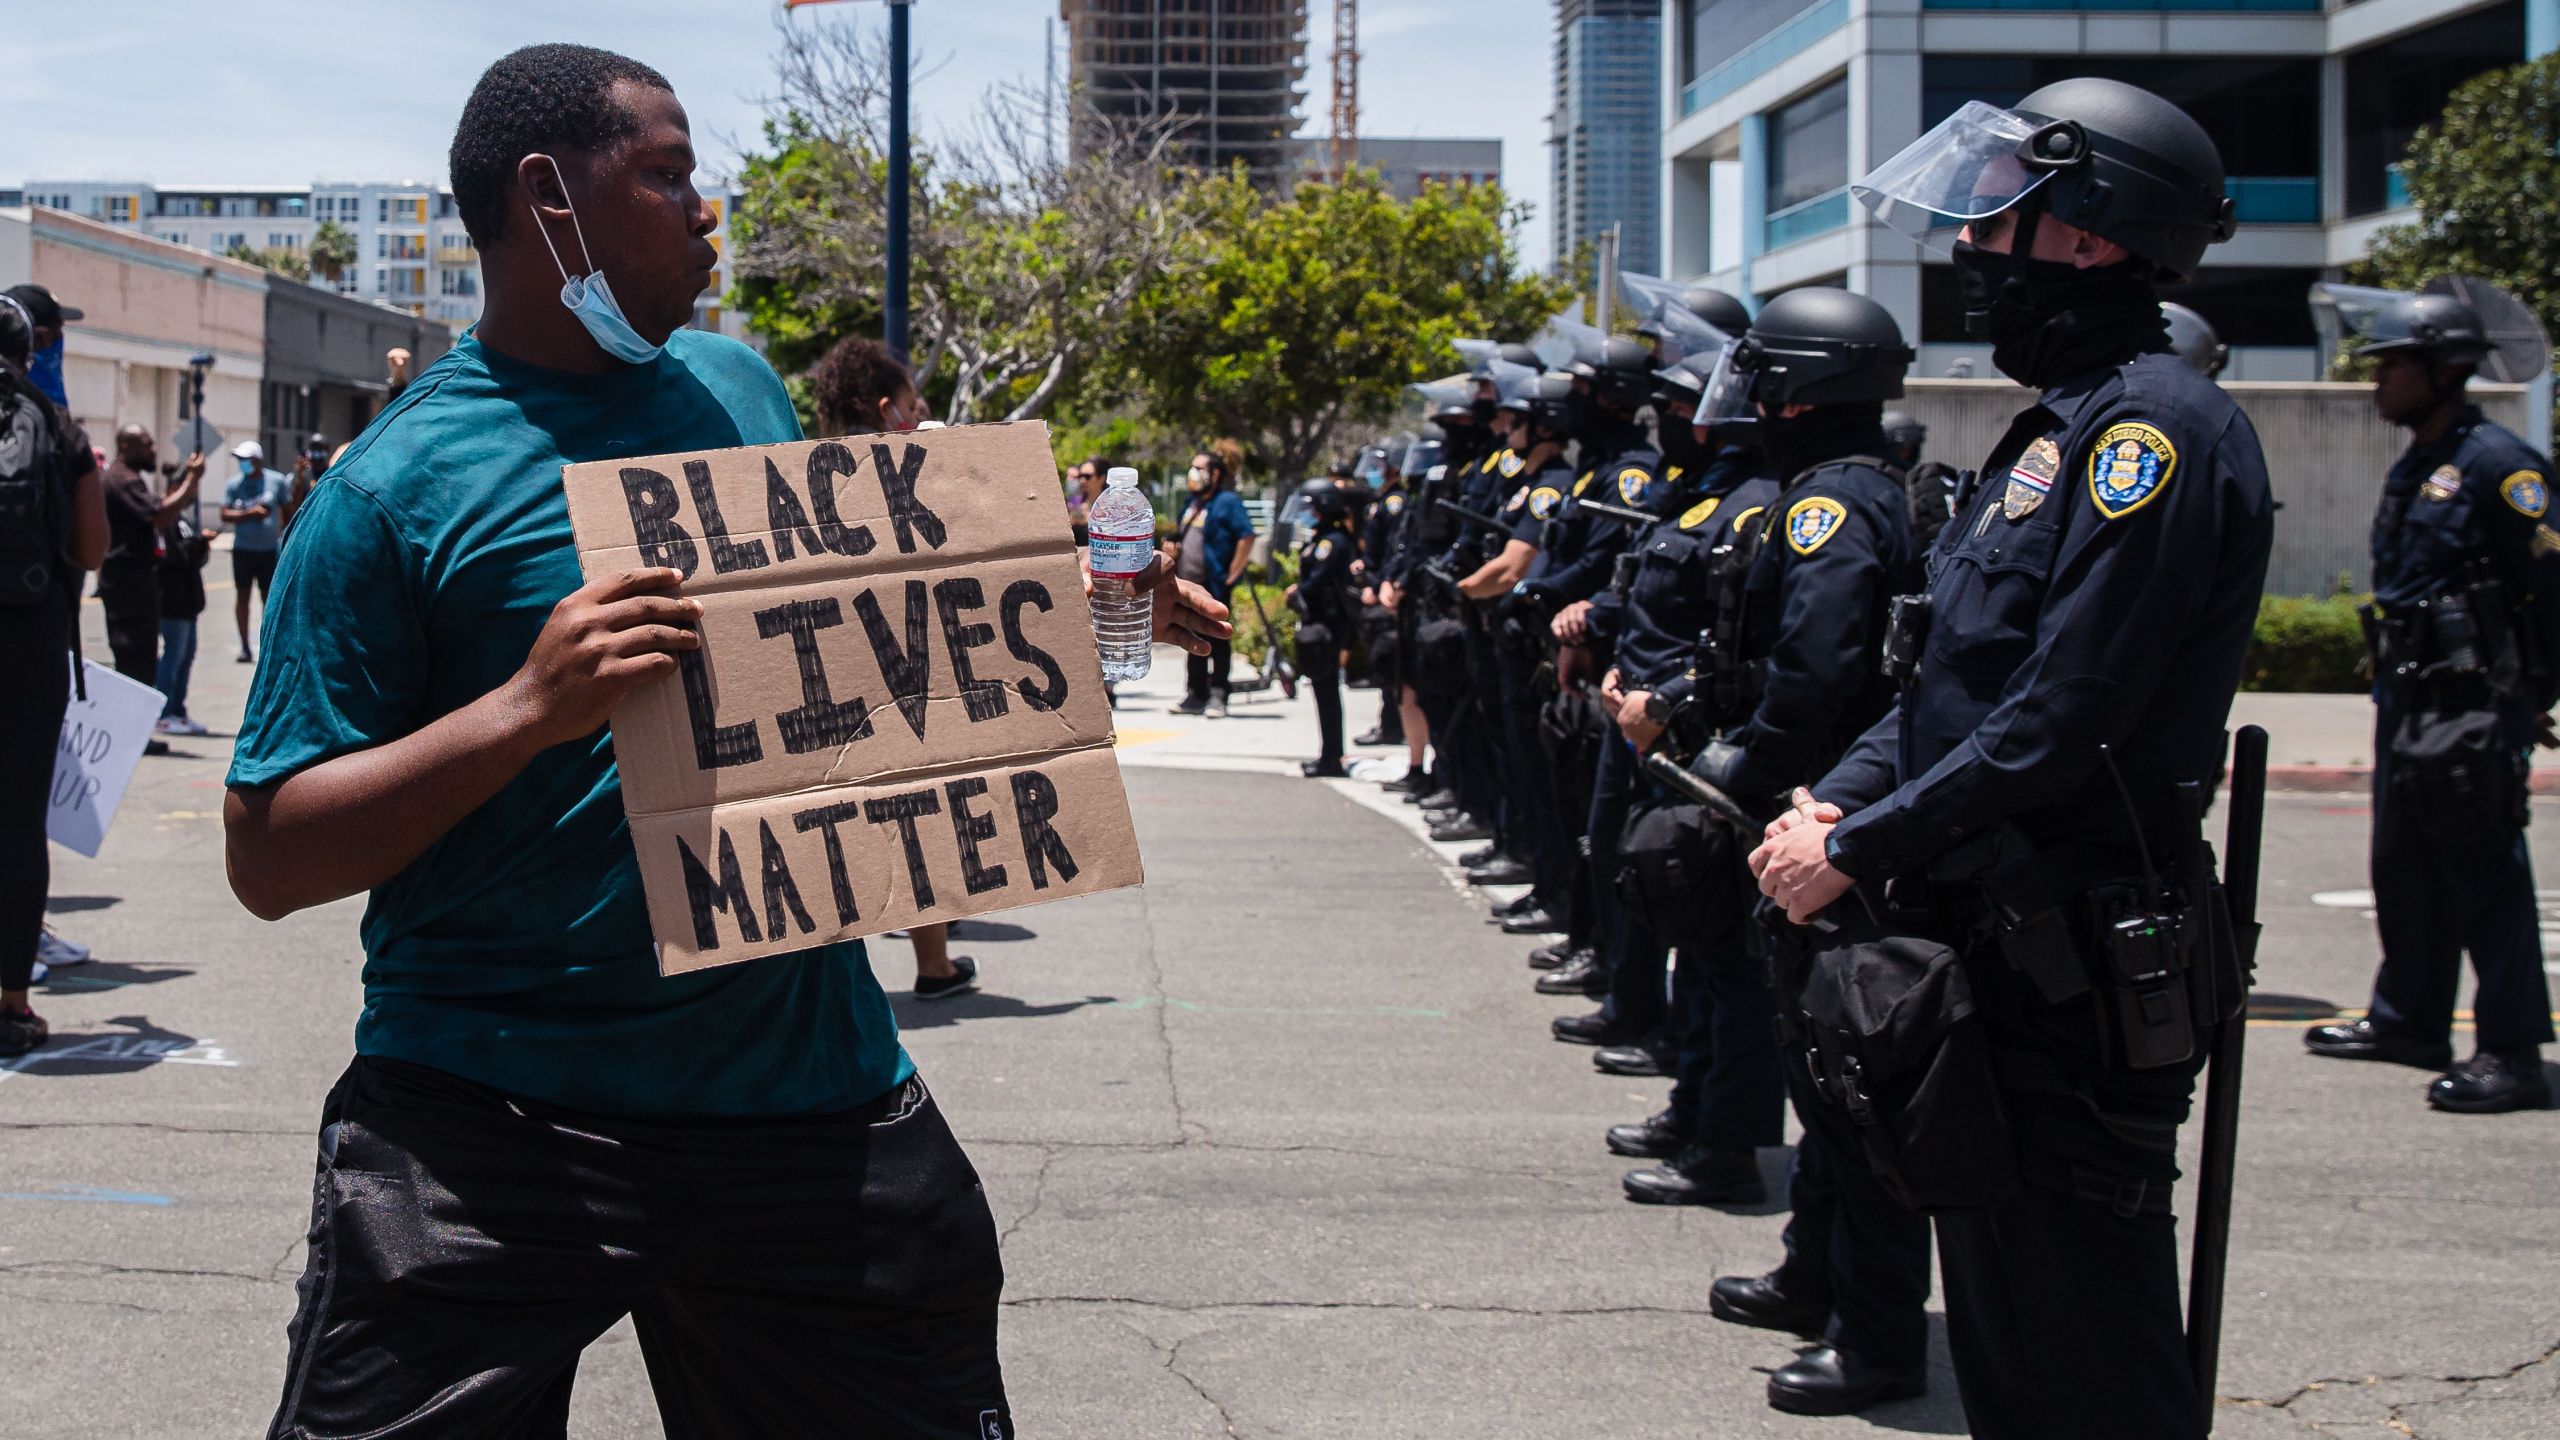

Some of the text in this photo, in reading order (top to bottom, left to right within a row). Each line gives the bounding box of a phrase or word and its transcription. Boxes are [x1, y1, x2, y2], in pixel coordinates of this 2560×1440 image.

[2140, 432, 2171, 462] POLICE
[619, 442, 948, 581] BLACK
[1095, 541, 1120, 551] GEYSER
[678, 578, 1068, 770] LIVES
[52, 769, 101, 811] UP
[676, 771, 1080, 951] MATTER
